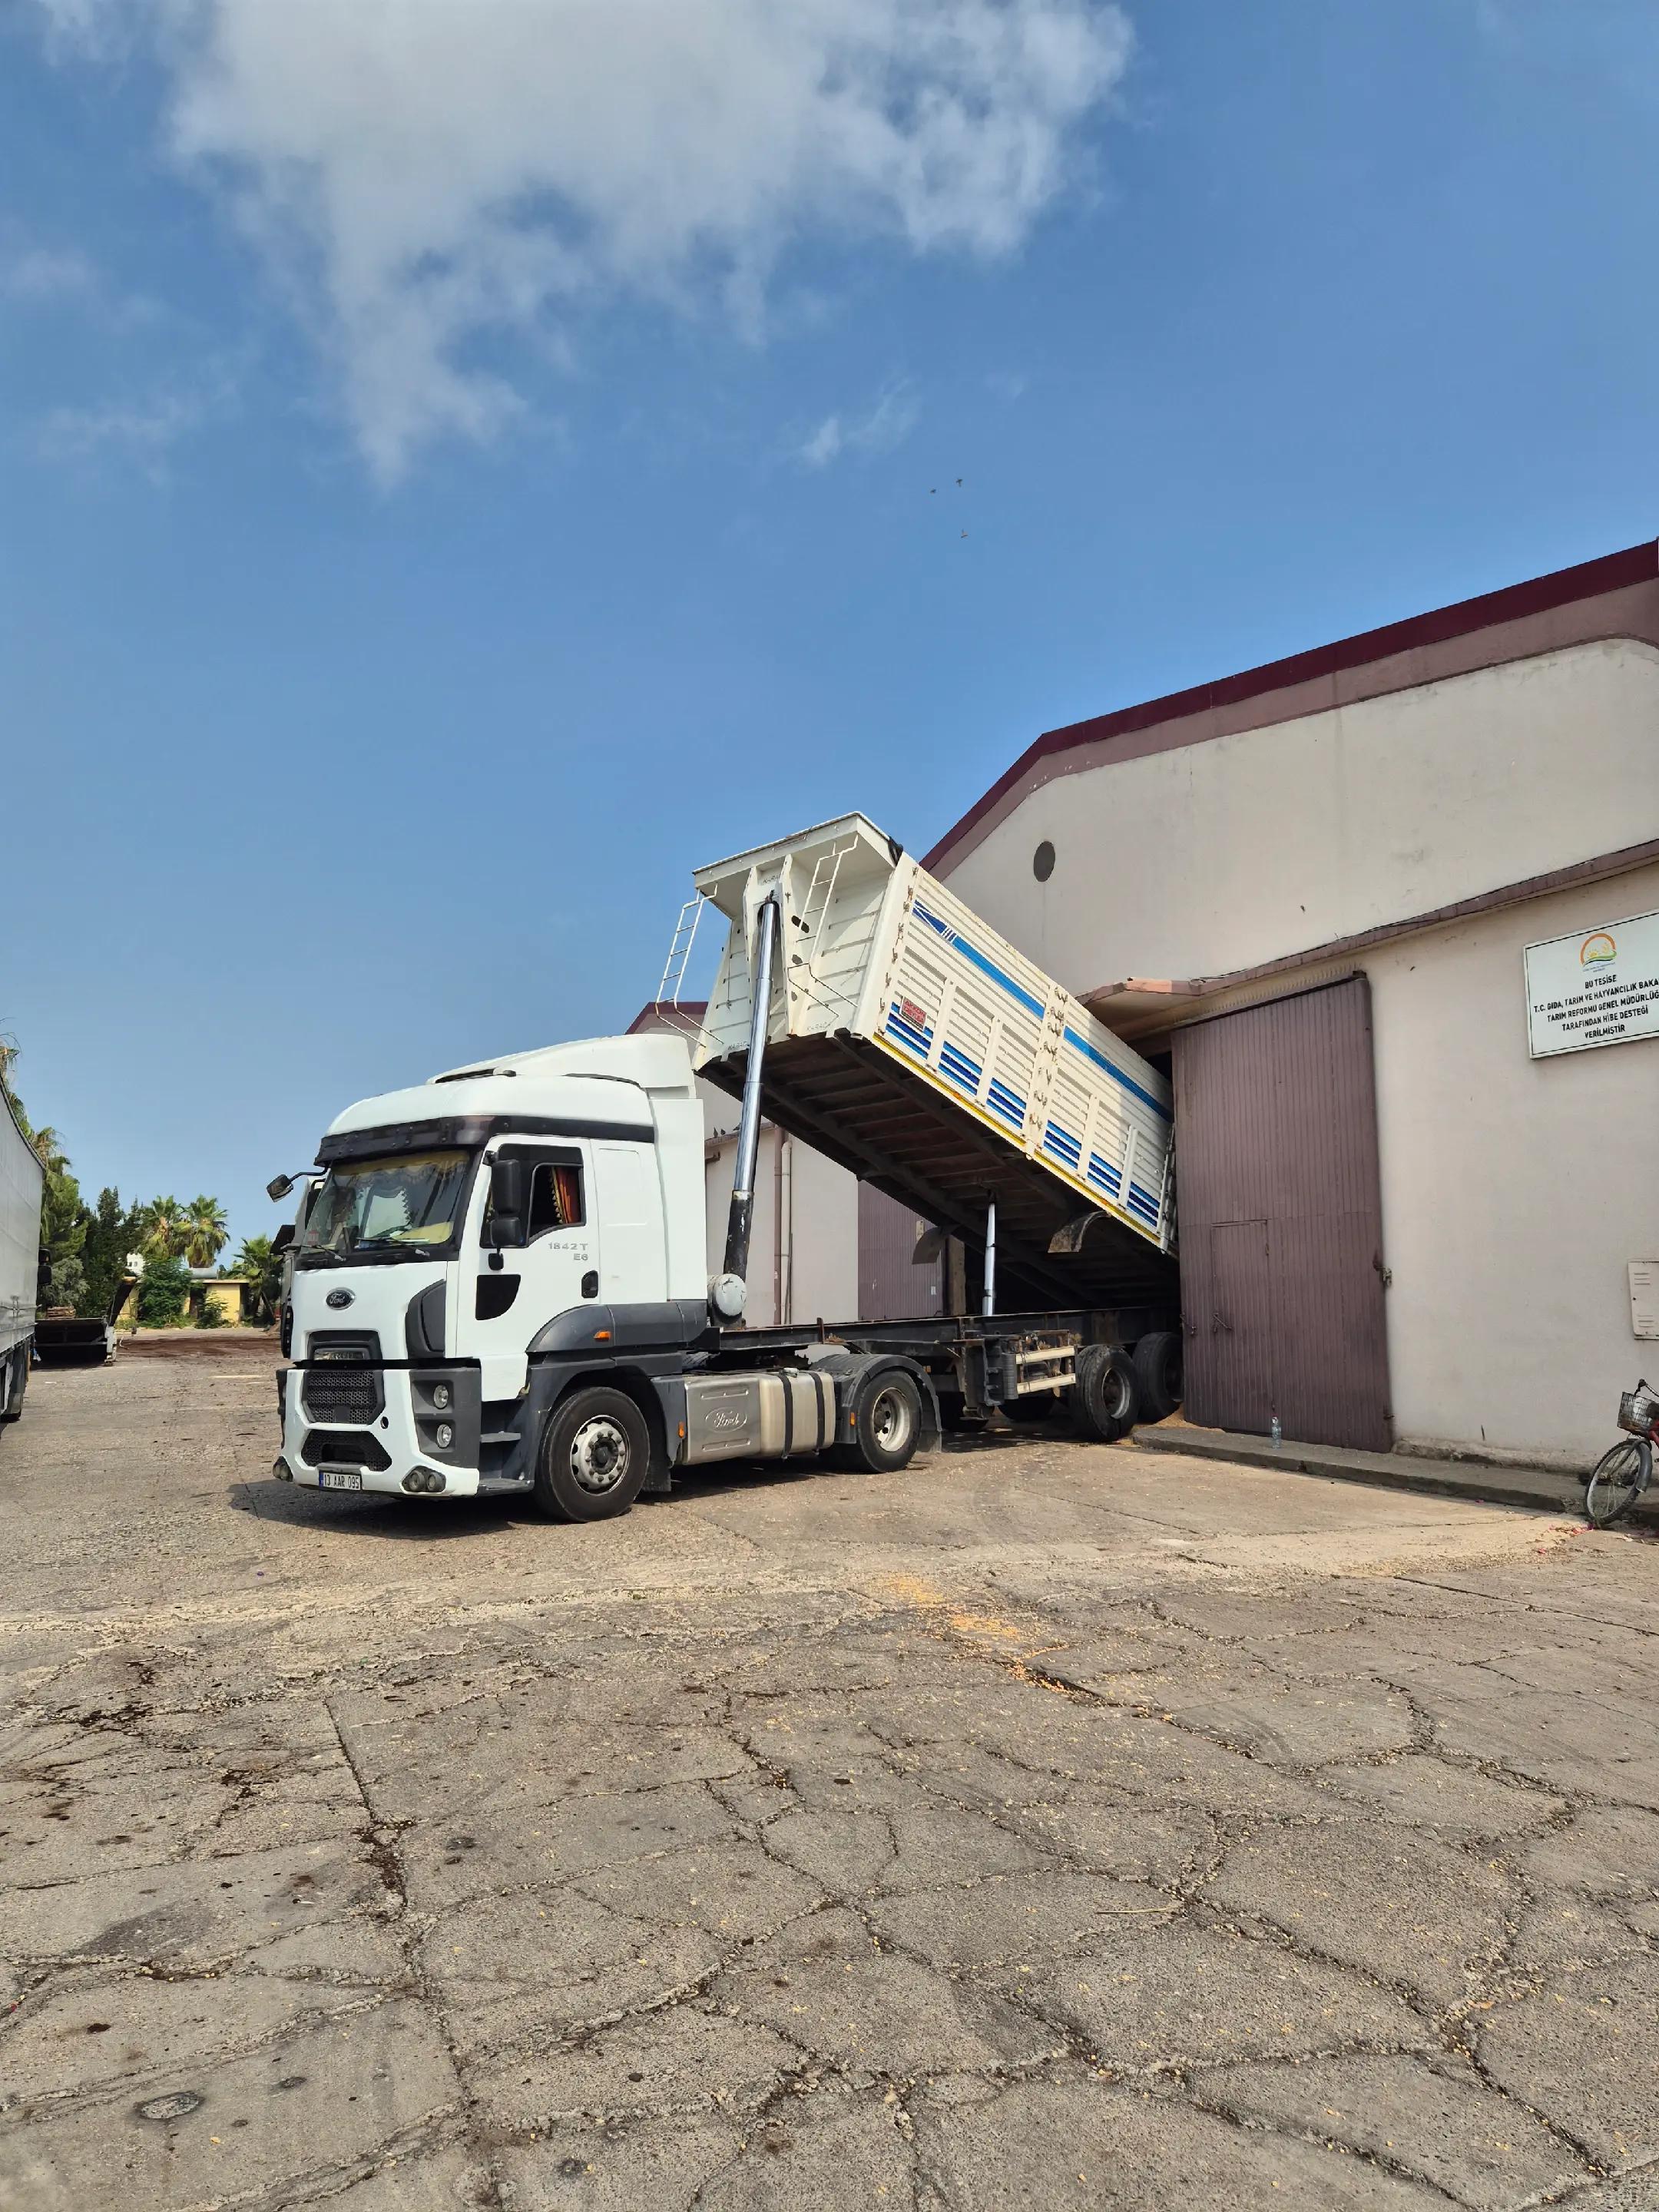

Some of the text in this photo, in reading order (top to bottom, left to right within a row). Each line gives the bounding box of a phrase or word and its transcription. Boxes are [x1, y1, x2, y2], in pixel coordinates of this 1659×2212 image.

[1584, 974, 1618, 989] BU TESİSE
[1534, 1004, 1546, 1013] T.C.
[1547, 1000, 1564, 1011] GIDA,
[1565, 995, 1584, 1006] TARIM
[1584, 993, 1593, 1002] VE
[1594, 982, 1637, 999] HAYVANCILIK
[1547, 1012, 1567, 1023] TARIM
[1568, 1004, 1598, 1018] REFORMU
[1598, 999, 1619, 1011] GENEL
[1561, 1005, 1649, 1031] TARAFINDAN HİBE DESTEĞİ
[1584, 1023, 1626, 1039] VERİLMİŞTİR
[573, 1253, 589, 1261] E6
[329, 1293, 346, 1304] Ford
[714, 1411, 740, 1428] Ford
[347, 1475, 359, 1489] 095
